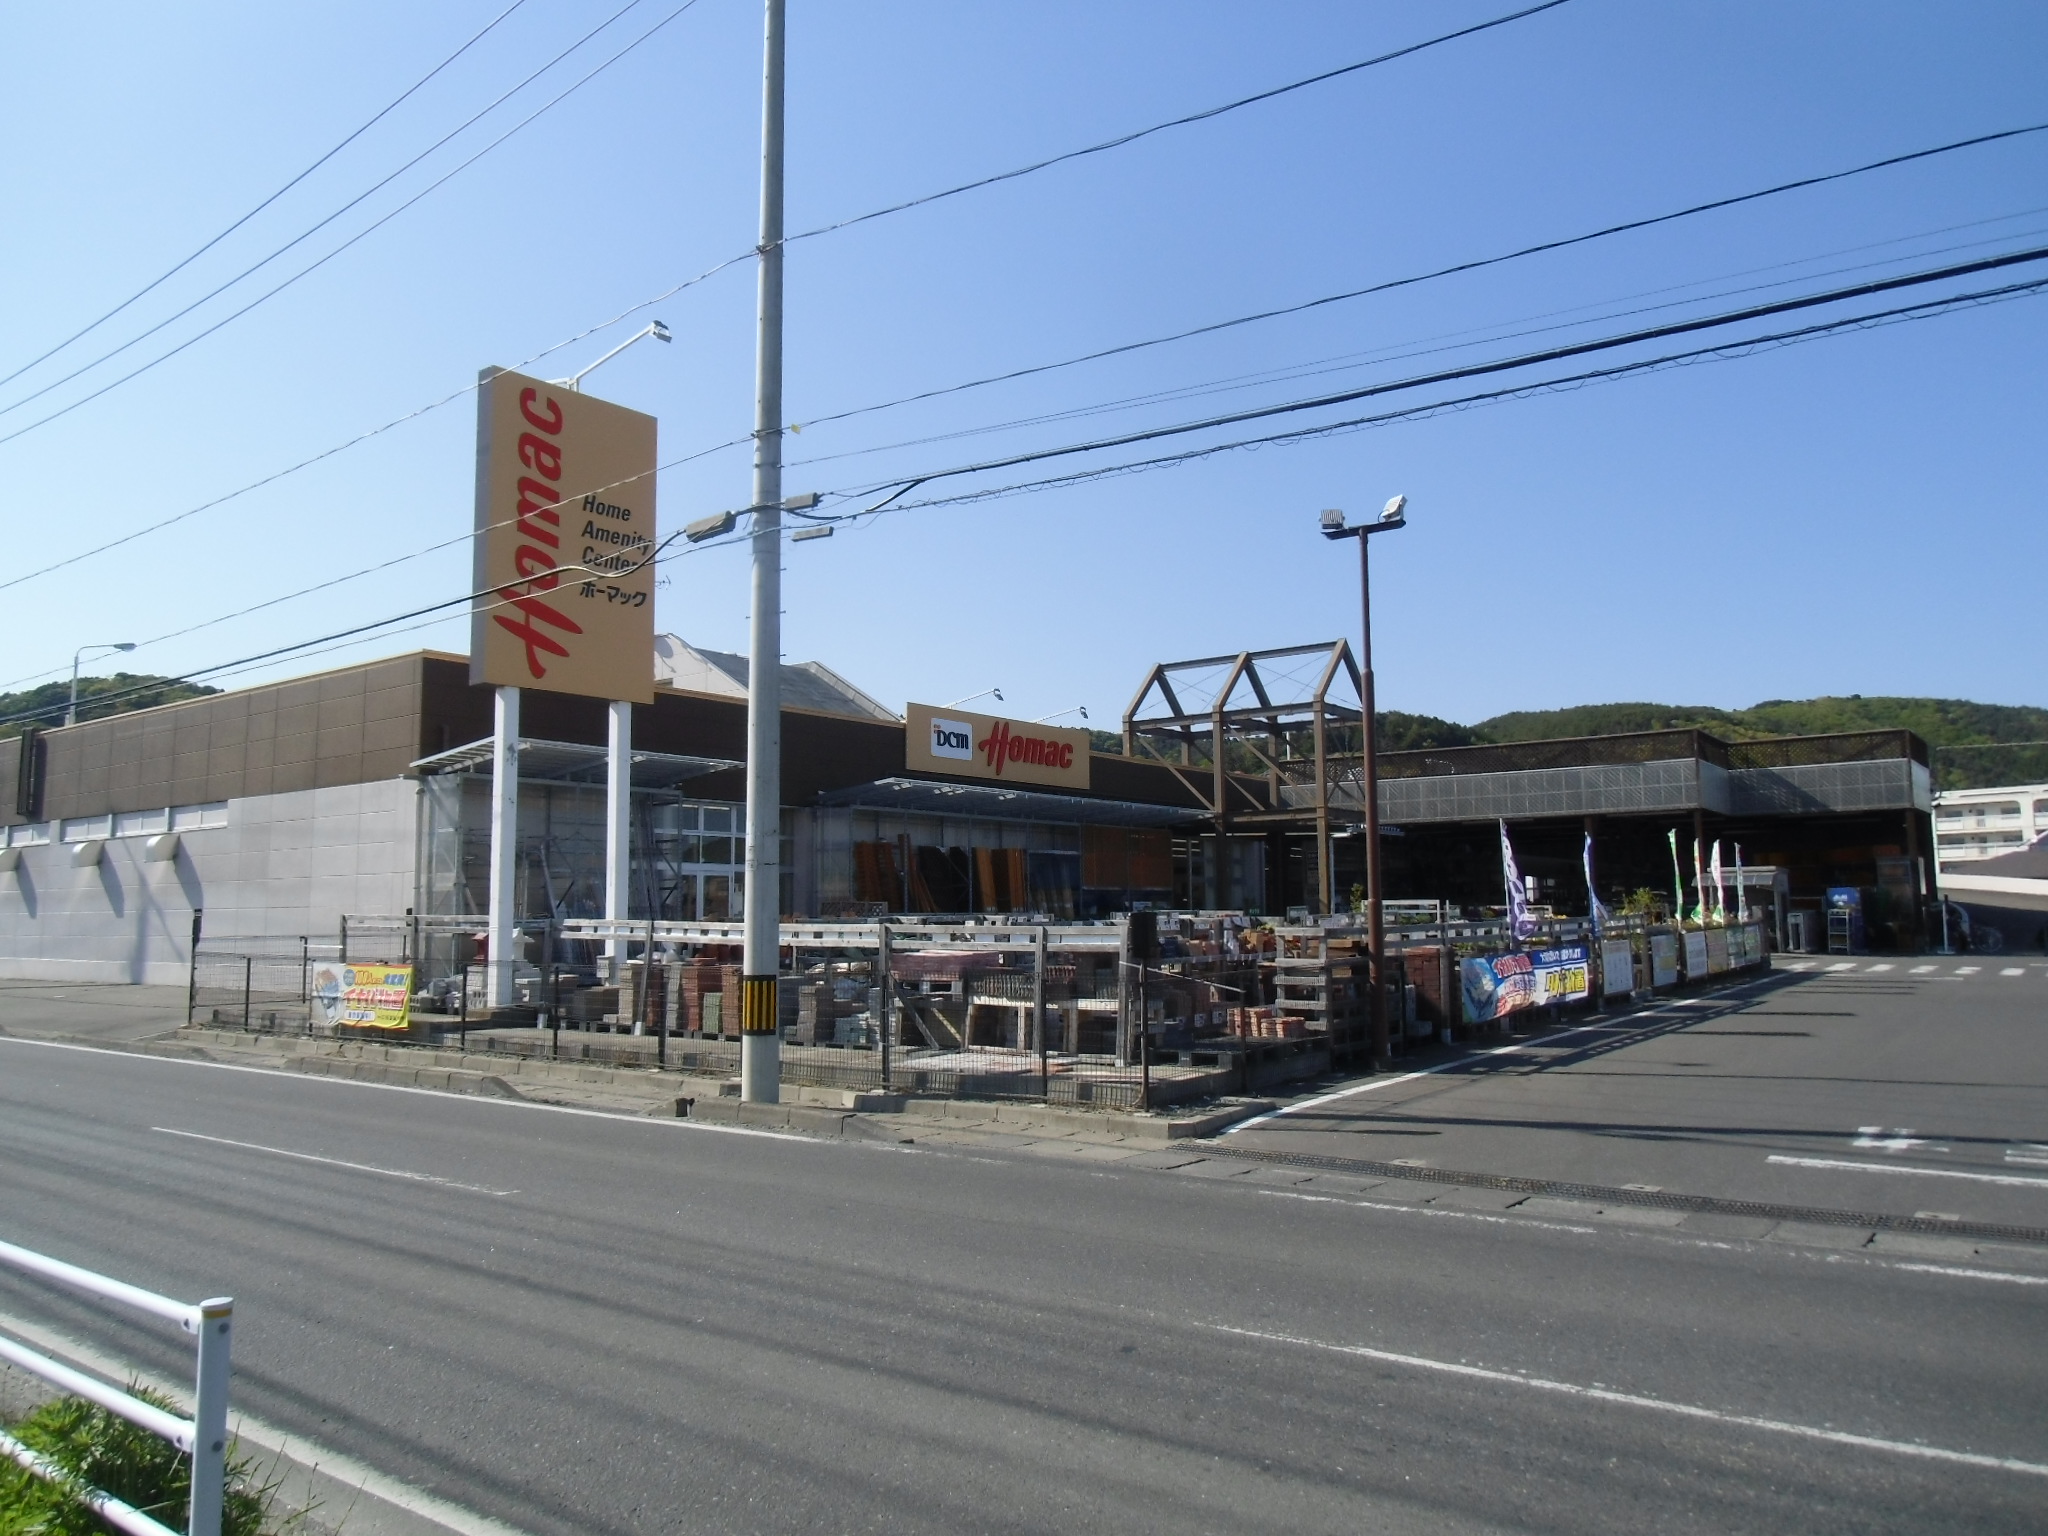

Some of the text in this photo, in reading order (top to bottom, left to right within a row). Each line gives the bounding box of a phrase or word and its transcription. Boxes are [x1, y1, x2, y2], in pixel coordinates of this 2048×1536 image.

[582, 494, 631, 521] Home
[492, 386, 583, 679] Homac
[581, 519, 653, 556] Amenity
[579, 581, 647, 608] ホーマック
[978, 720, 1074, 776] Homac
